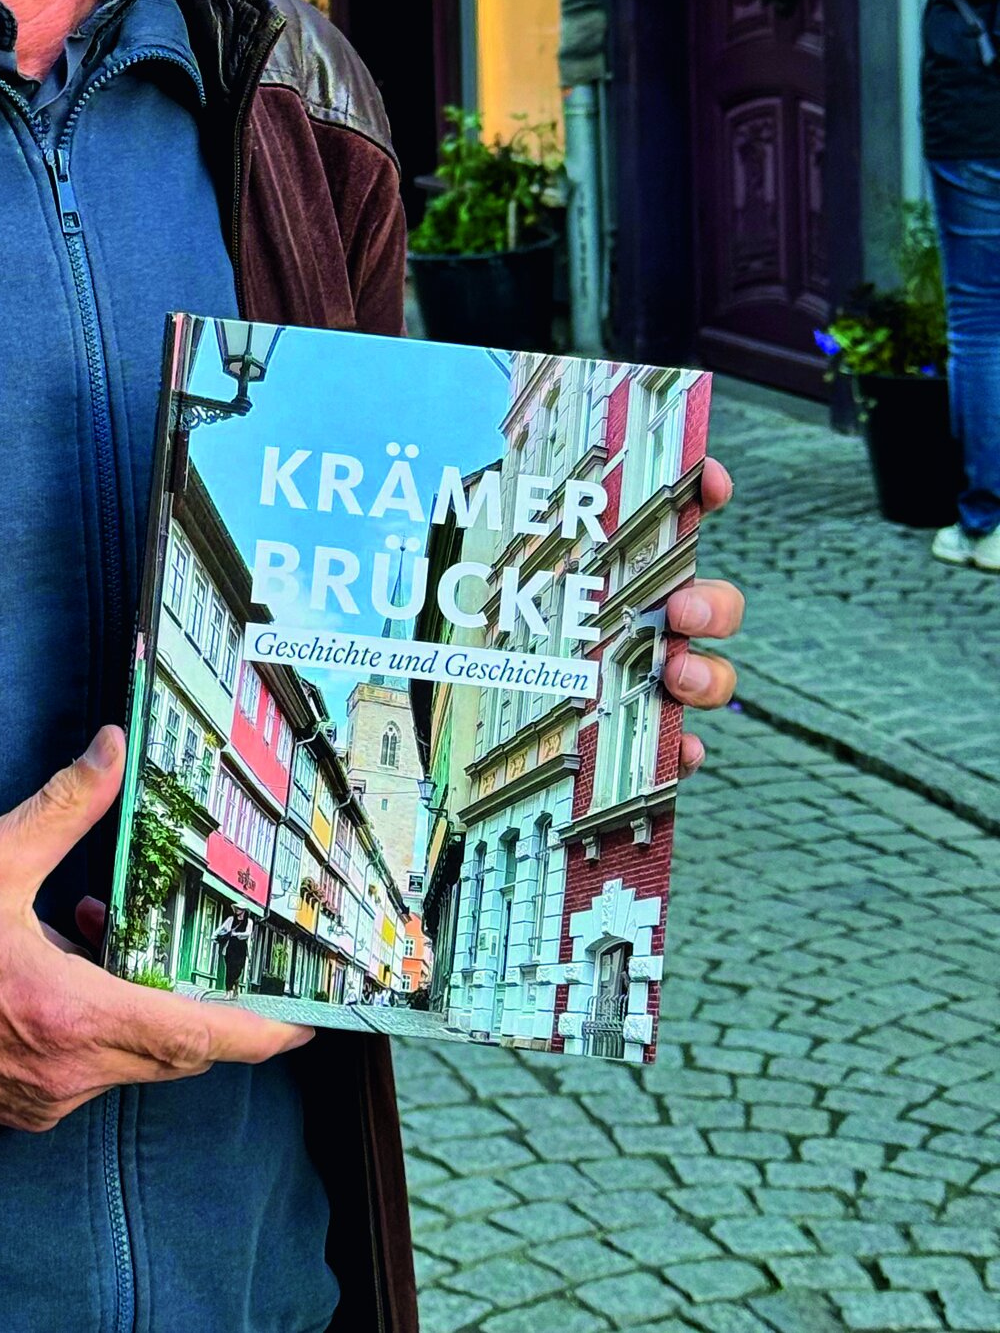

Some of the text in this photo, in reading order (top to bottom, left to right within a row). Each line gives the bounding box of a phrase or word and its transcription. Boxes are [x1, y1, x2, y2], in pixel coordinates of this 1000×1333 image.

[258, 441, 609, 544] KRÄMER
[250, 534, 605, 643] BRÜCKE
[253, 631, 589, 692] Geschichte und Geschichten
